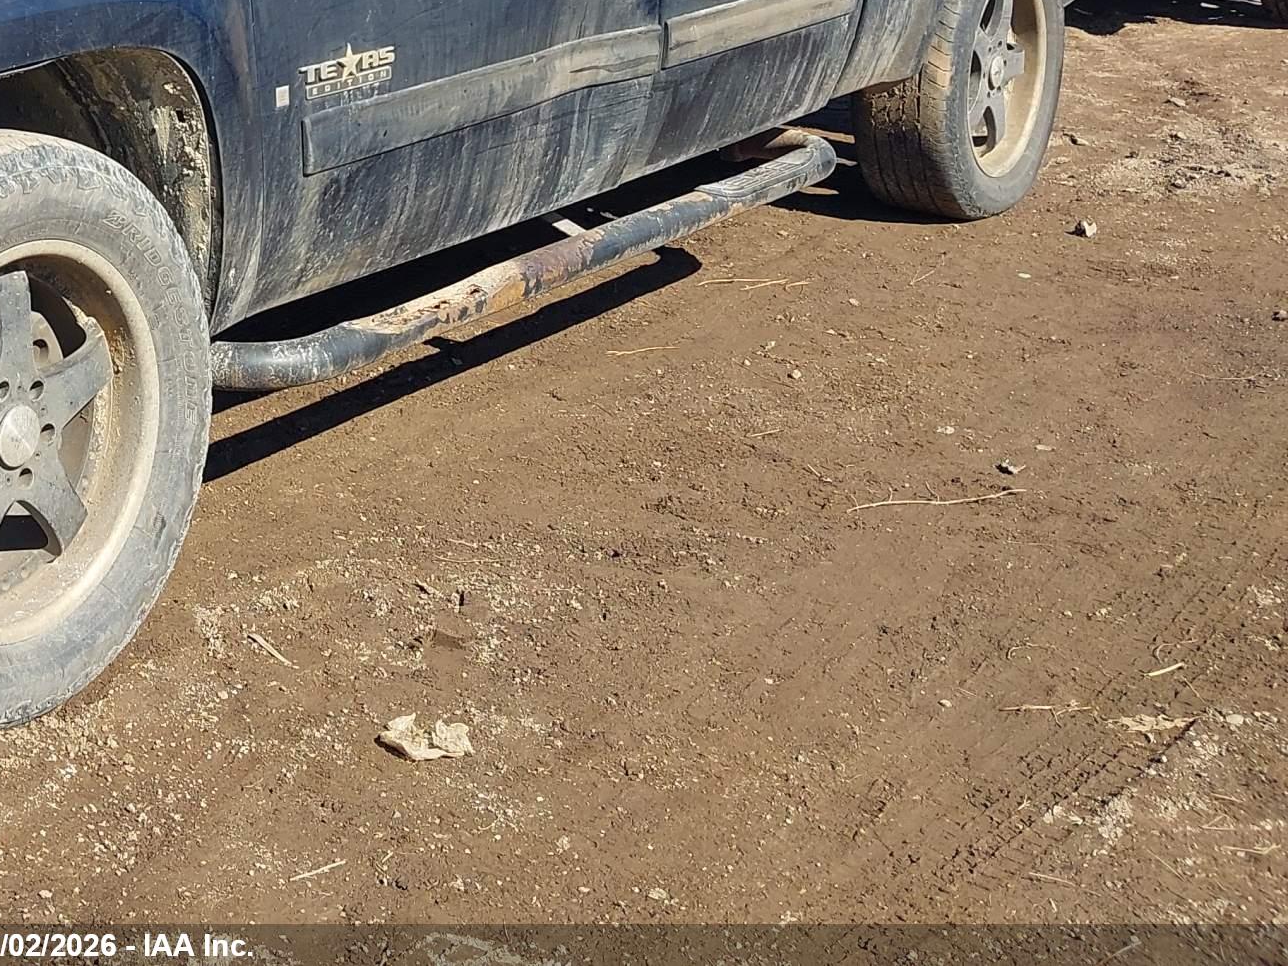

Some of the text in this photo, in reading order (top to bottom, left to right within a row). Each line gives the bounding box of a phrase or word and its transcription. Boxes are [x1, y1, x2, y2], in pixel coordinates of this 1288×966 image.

[298, 42, 396, 83] TEXAS
[311, 70, 388, 96] EDITION
[103, 210, 198, 426] BRIDGESTONE
